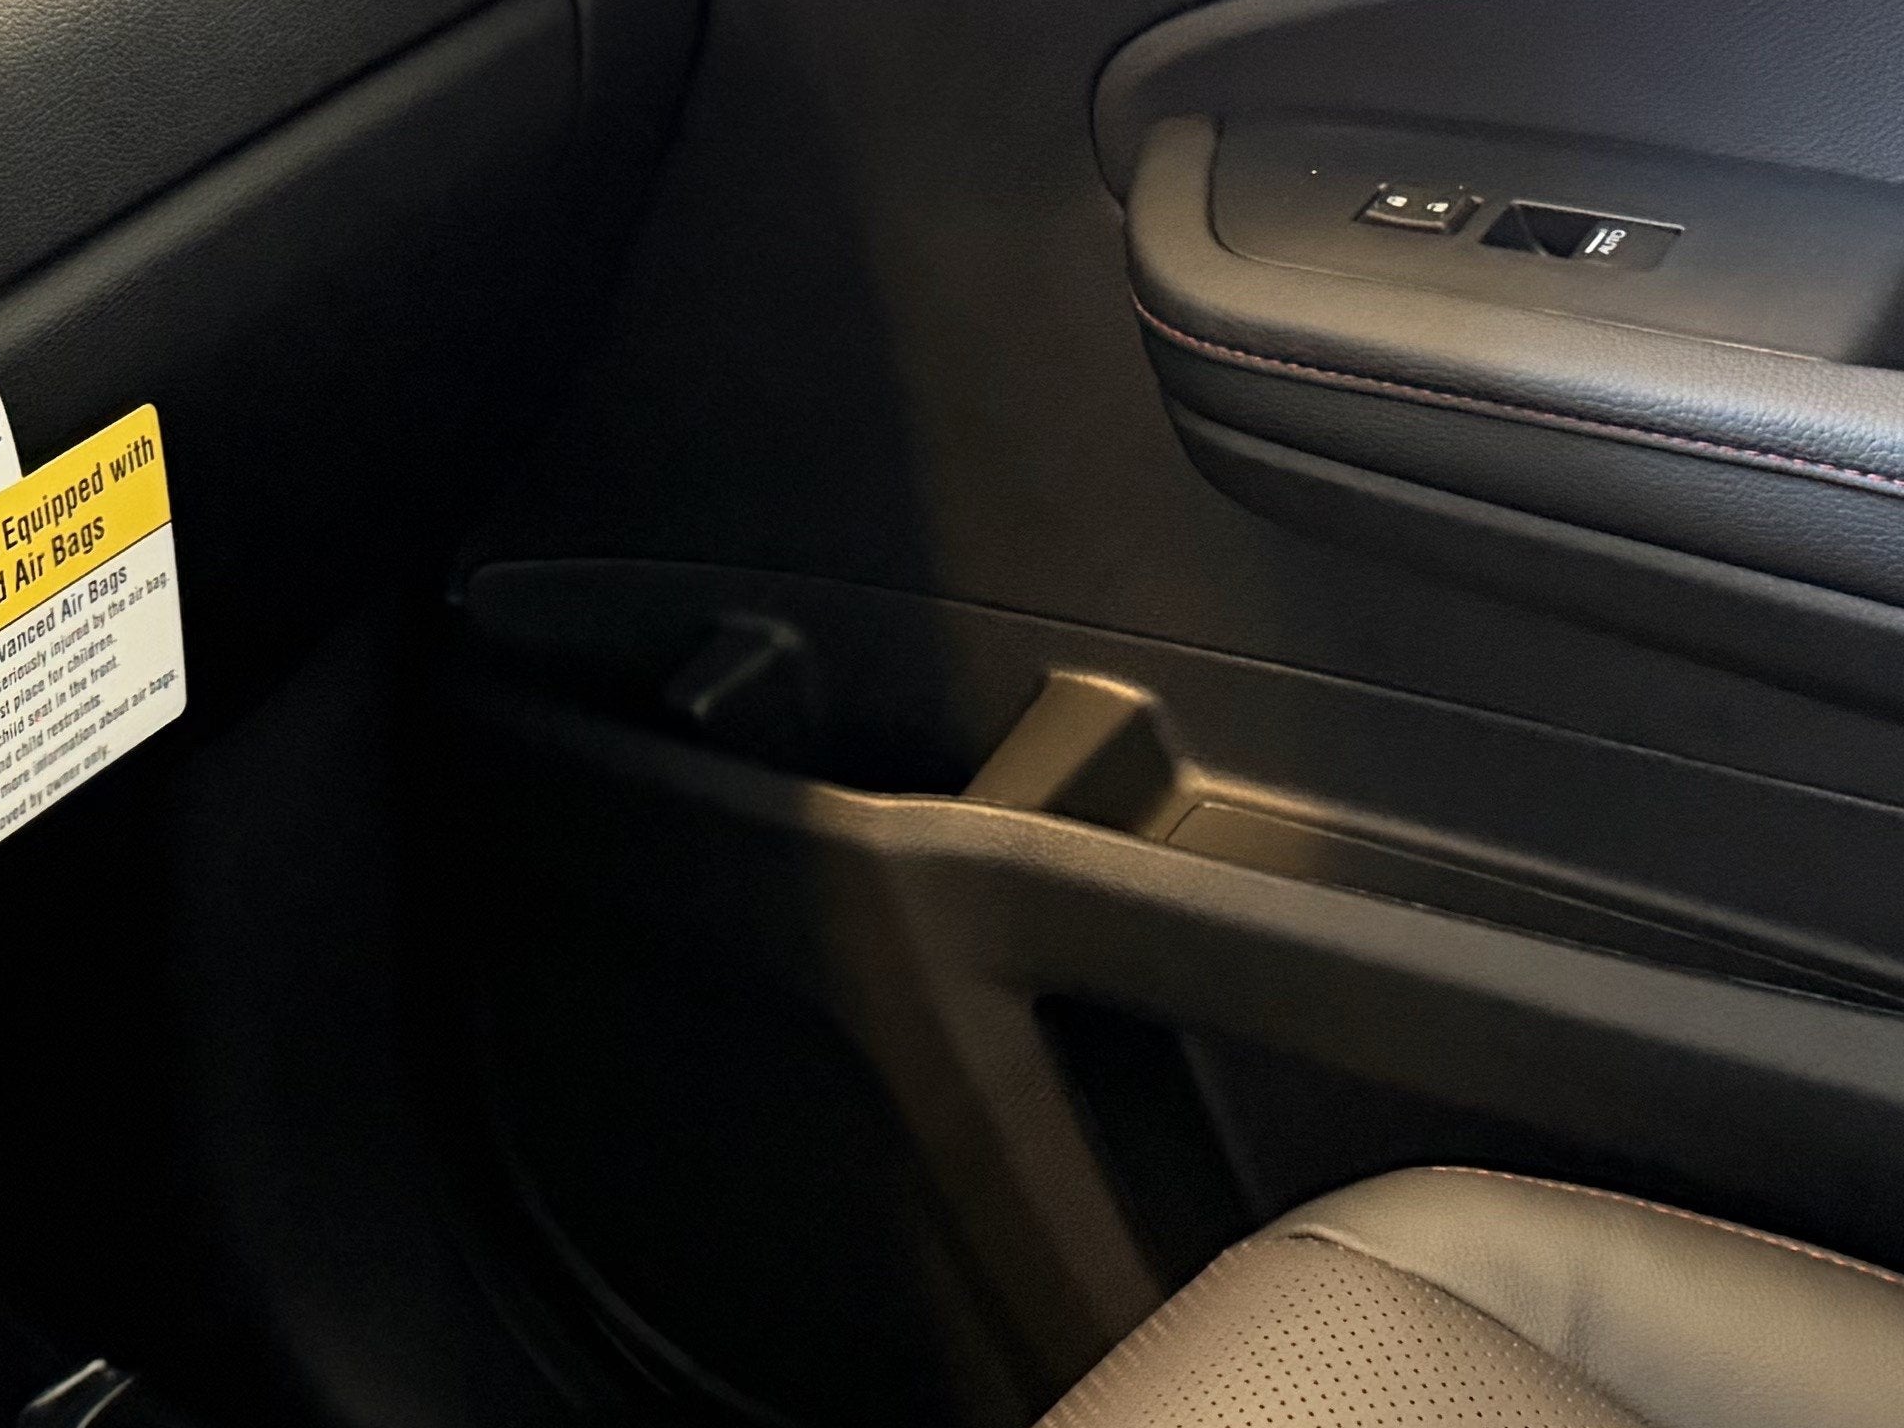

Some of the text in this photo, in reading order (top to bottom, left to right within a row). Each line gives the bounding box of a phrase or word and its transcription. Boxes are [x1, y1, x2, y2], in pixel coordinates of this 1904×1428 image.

[2, 463, 104, 551] Equipped
[110, 435, 155, 483] with
[15, 551, 44, 594] Air
[51, 516, 106, 568] Bags
[51, 619, 90, 658] injured
[92, 611, 106, 630] by
[108, 598, 126, 620] the
[128, 585, 144, 606] air
[146, 572, 170, 595] bag.
[60, 592, 84, 623] Air
[88, 566, 128, 604] Bags
[14, 679, 45, 713] place
[48, 666, 64, 686] for
[27, 698, 53, 727] seat
[56, 691, 67, 709] in
[69, 677, 88, 699] the
[0, 769, 31, 799] more
[99, 698, 129, 730] about
[131, 687, 147, 707] air
[15, 729, 44, 762] child
